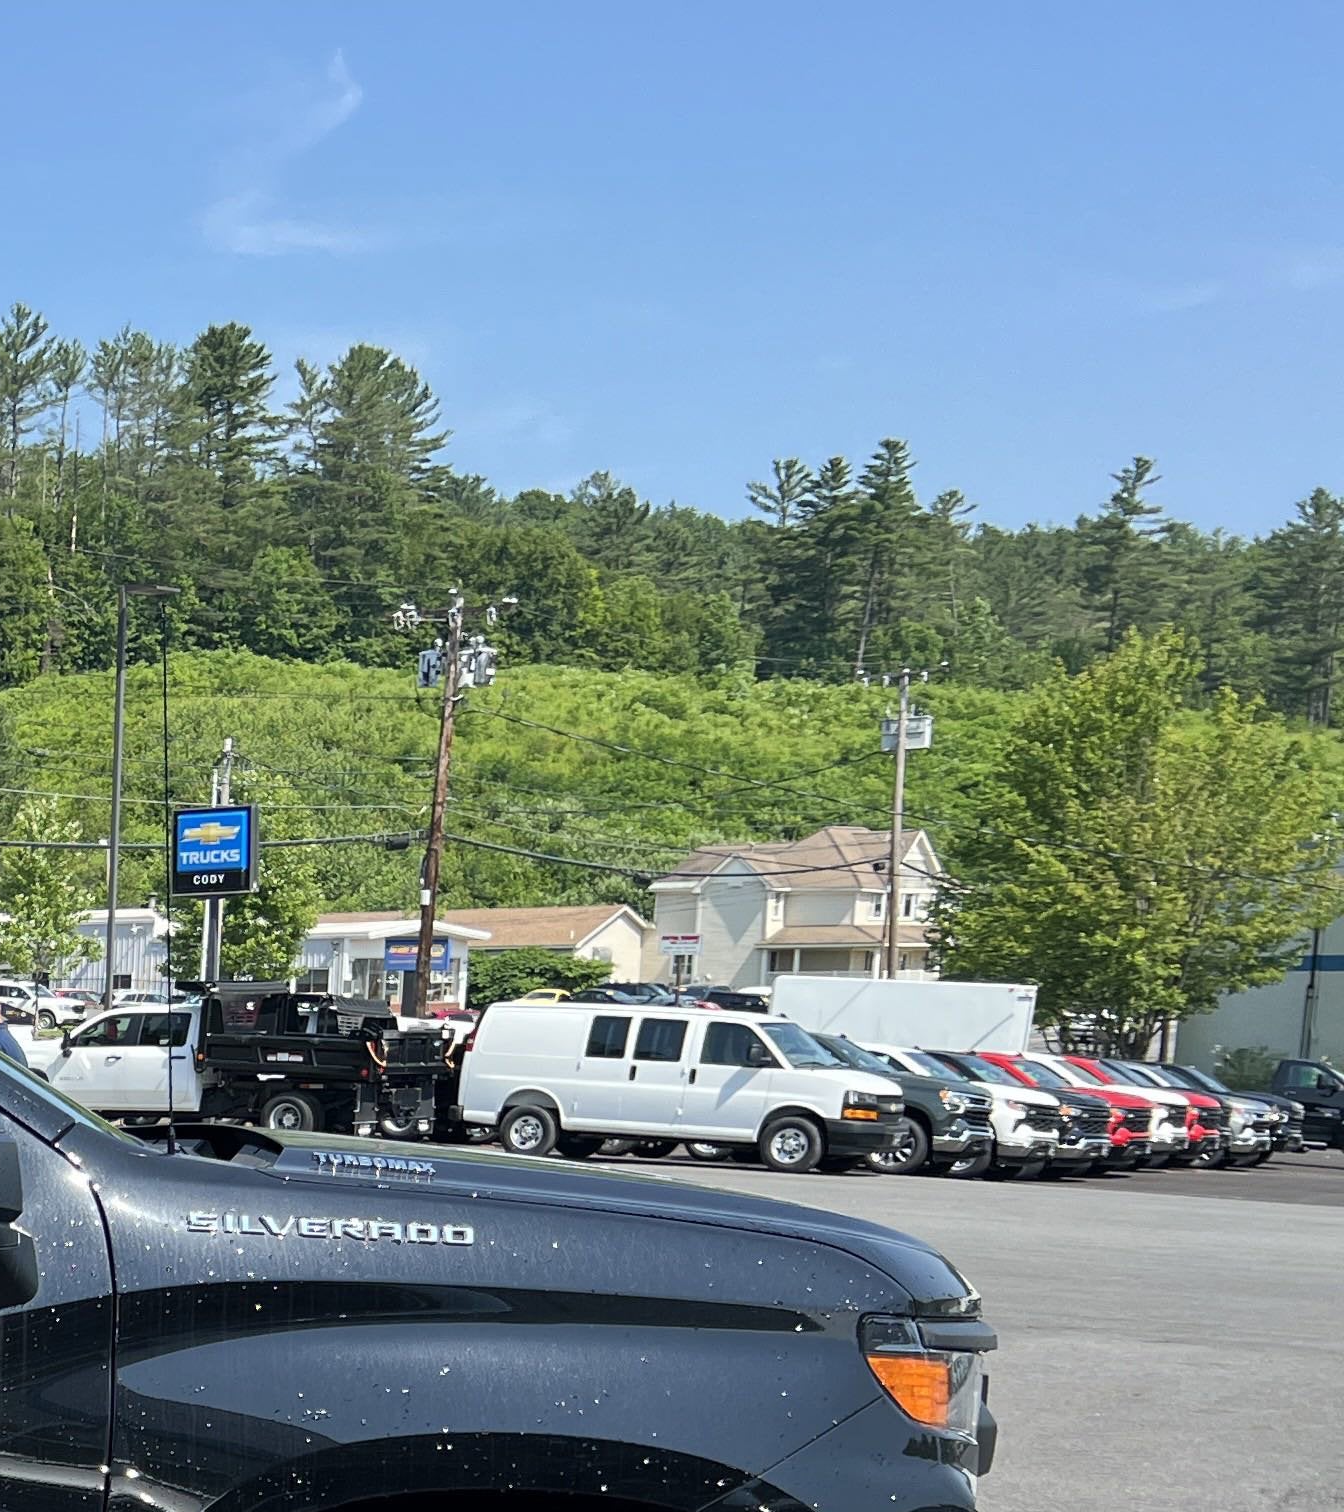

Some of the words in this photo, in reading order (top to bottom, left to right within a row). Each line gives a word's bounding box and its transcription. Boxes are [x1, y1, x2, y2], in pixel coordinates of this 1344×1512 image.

[179, 849, 241, 865] TRUCKS
[192, 874, 225, 885] CODY
[312, 1151, 436, 1175] TURBOMAX
[186, 1210, 475, 1246] SILVERADO
